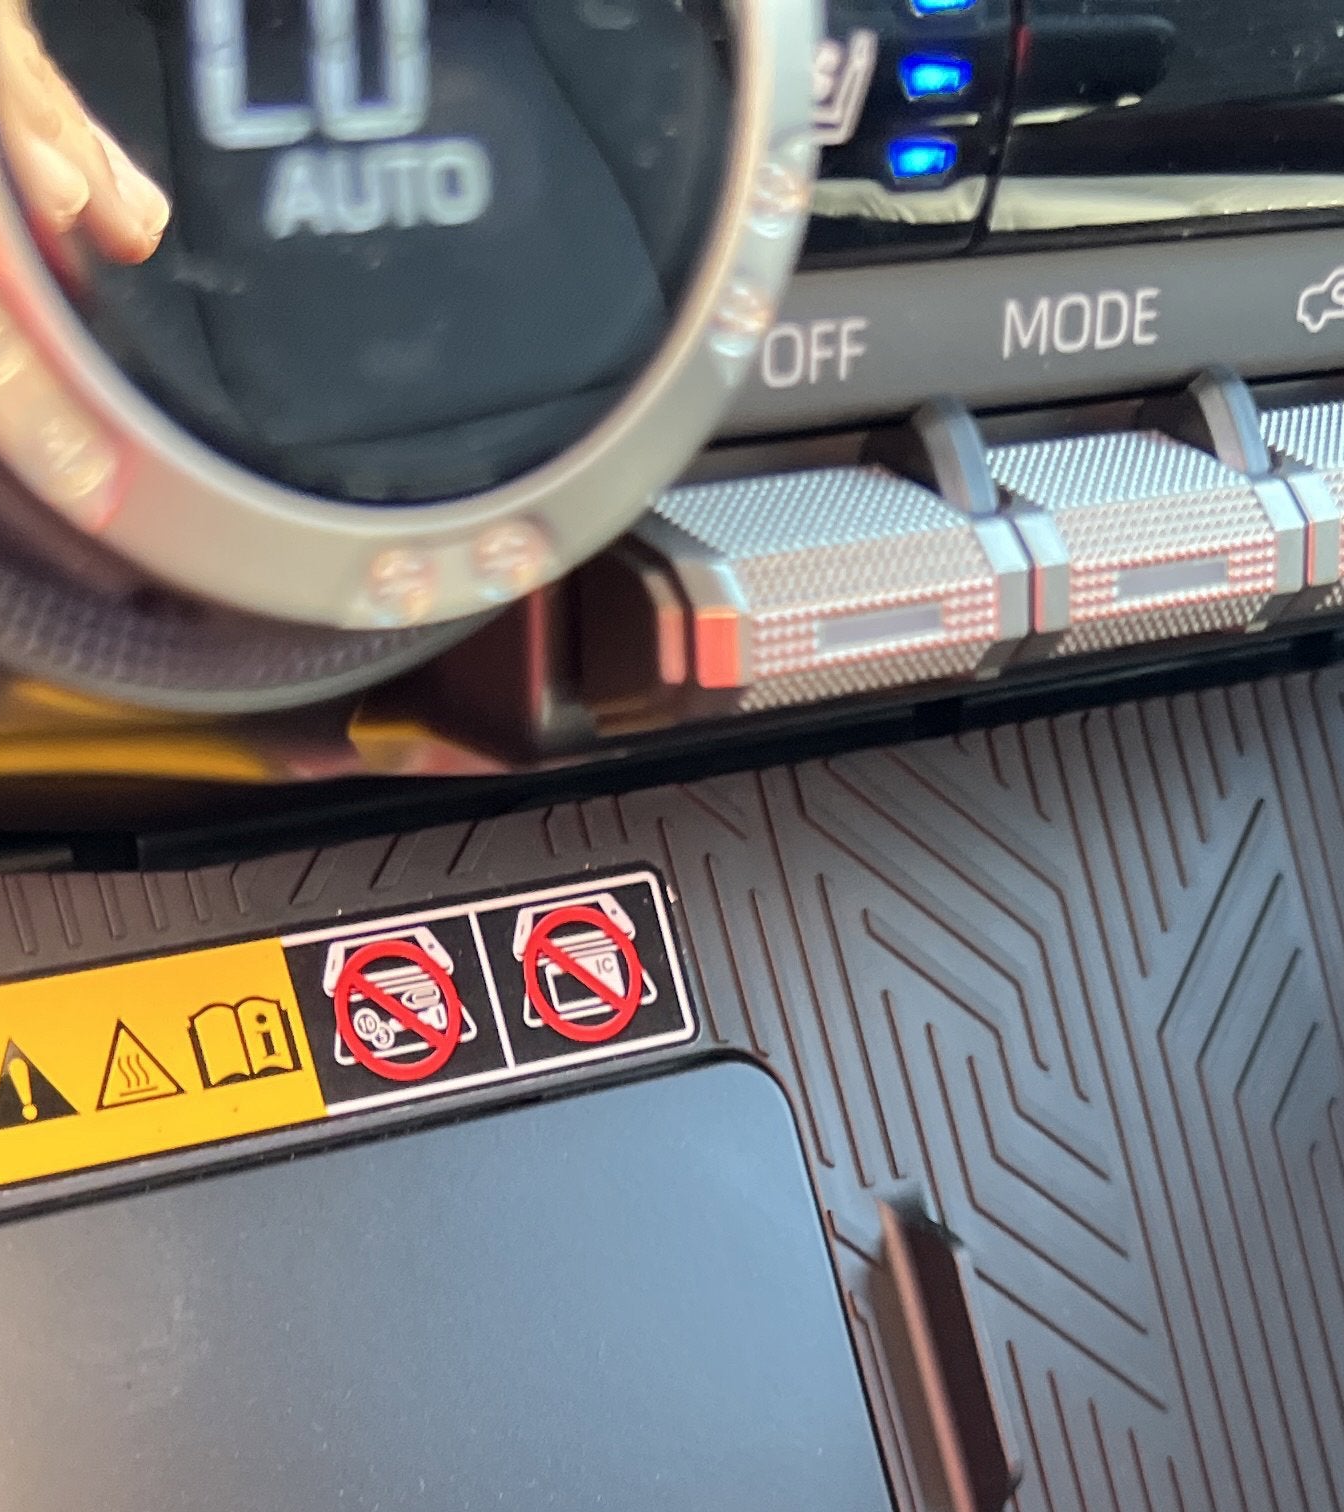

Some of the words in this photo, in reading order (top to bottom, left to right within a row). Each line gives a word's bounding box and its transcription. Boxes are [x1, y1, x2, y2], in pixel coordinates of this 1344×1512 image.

[263, 136, 492, 240] AUTO
[762, 315, 869, 389] OFF
[1002, 287, 1161, 361] MODE
[595, 956, 614, 975] IC
